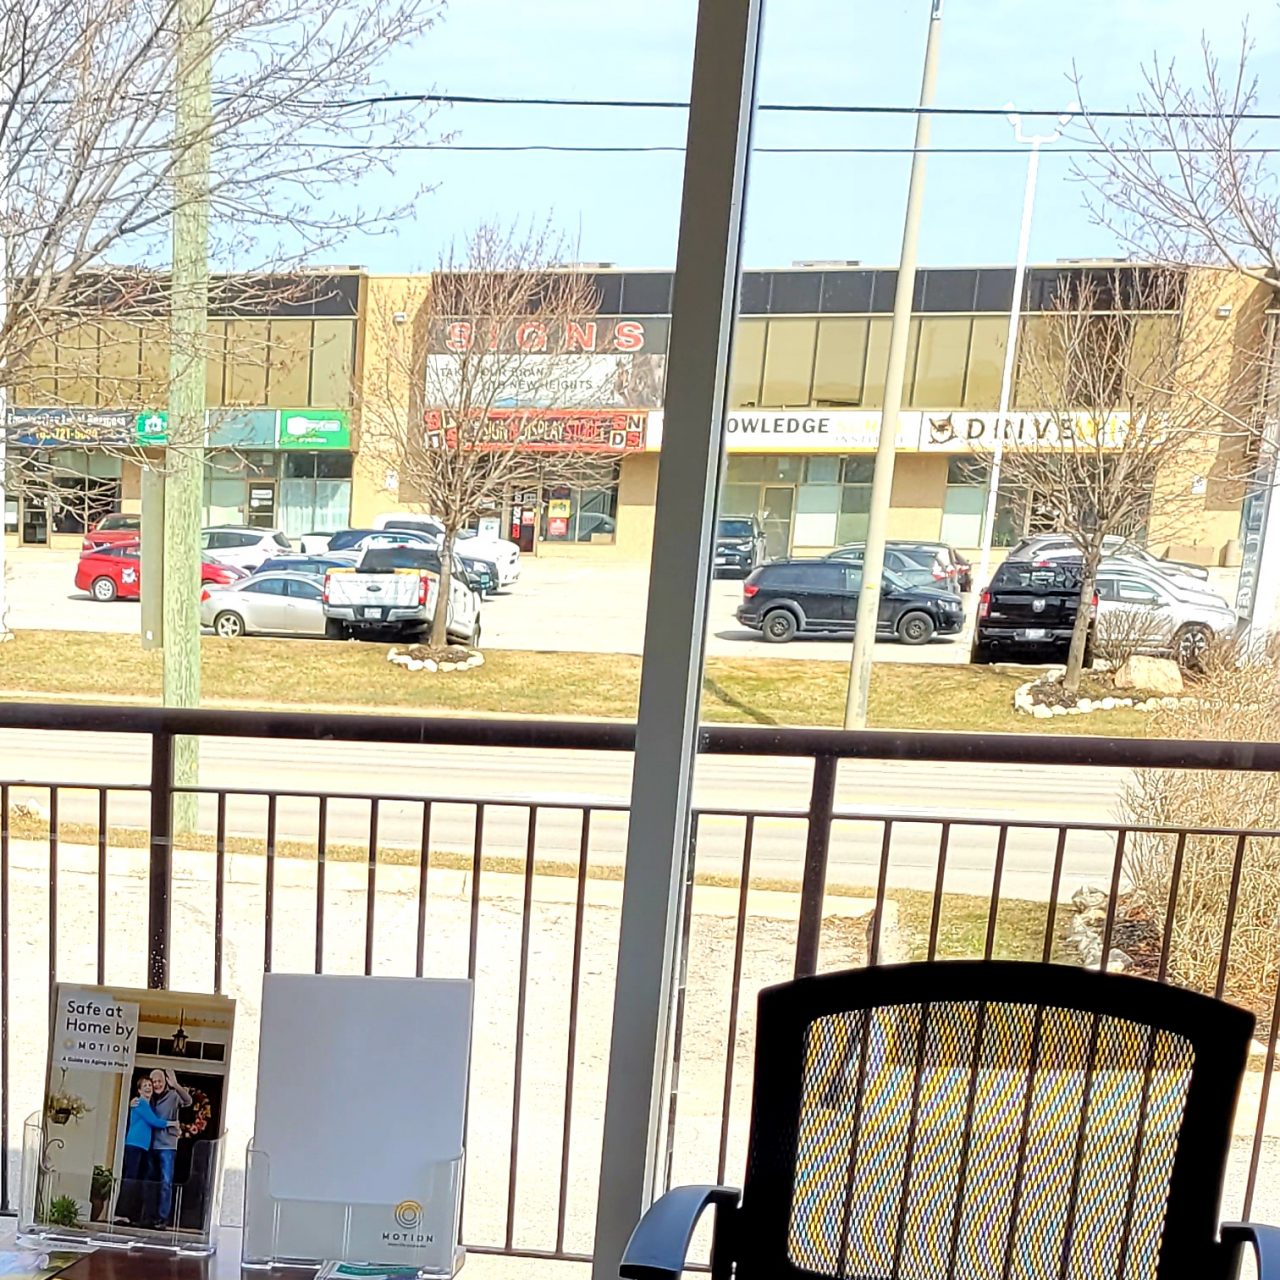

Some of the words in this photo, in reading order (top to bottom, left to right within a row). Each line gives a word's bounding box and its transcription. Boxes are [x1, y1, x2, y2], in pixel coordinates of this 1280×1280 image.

[727, 418, 829, 433] OWLEDGE
[67, 1001, 101, 1016] Safe
[105, 1006, 123, 1018] at
[66, 1017, 111, 1034] Home
[116, 1022, 134, 1040] by
[78, 1041, 129, 1054] MOTION
[382, 1232, 433, 1243] MOTION
